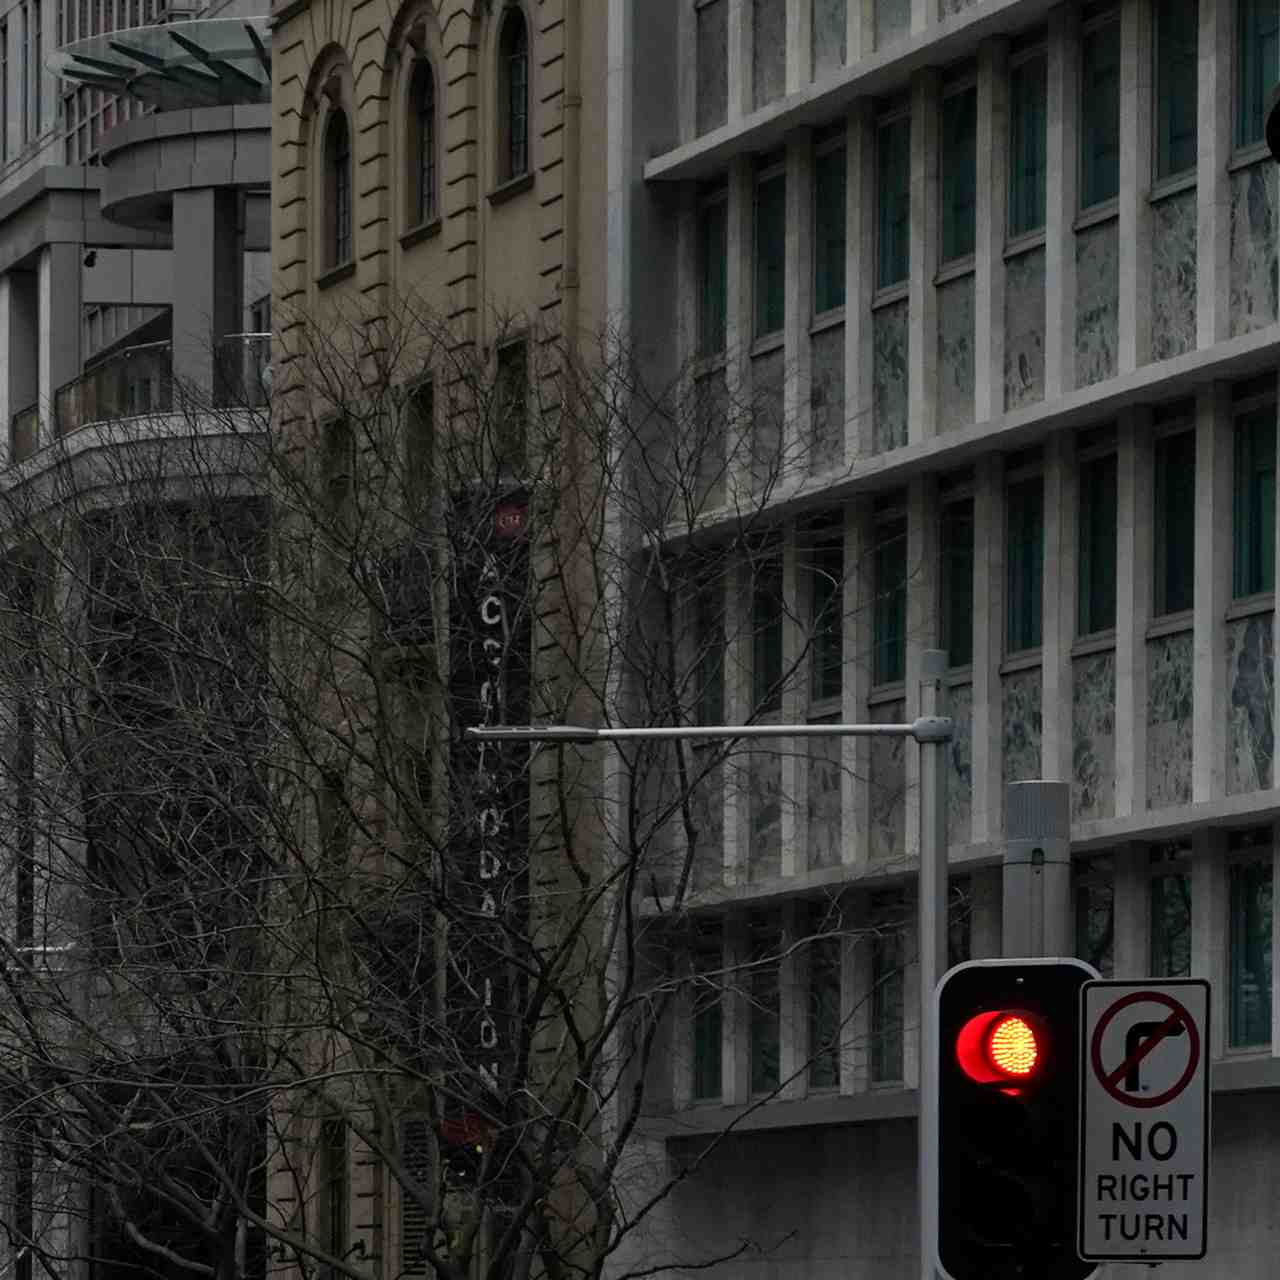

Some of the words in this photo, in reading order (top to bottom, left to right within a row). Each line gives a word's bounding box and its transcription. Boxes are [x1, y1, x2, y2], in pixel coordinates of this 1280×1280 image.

[1112, 1121, 1178, 1161] NO
[1097, 1174, 1195, 1201] RIGHT
[1099, 1213, 1188, 1241] TURN
